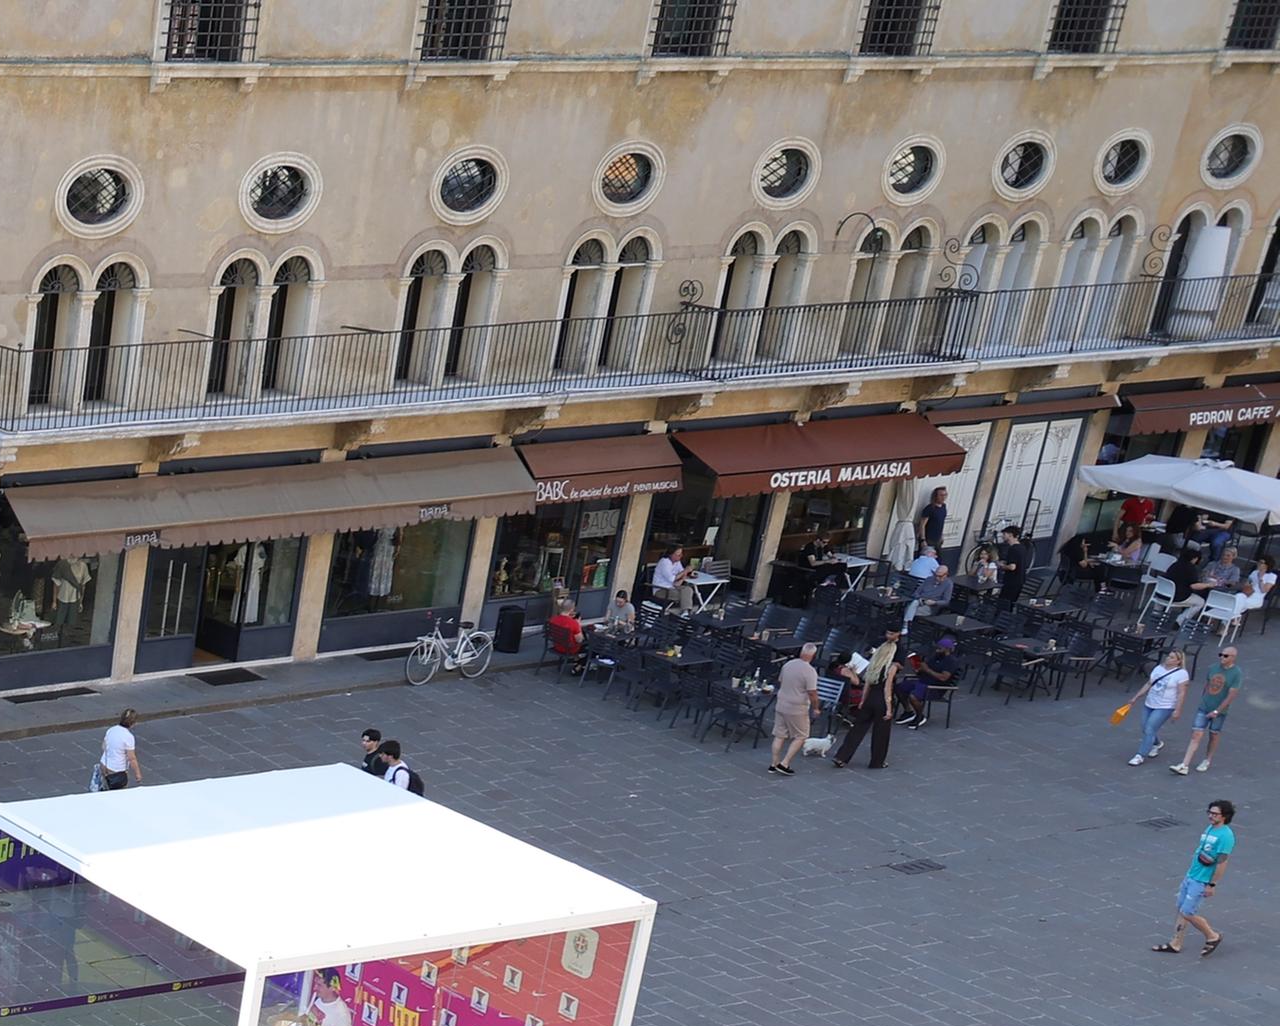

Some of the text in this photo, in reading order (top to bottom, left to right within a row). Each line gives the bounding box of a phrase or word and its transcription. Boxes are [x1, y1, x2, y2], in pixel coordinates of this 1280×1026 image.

[1189, 409, 1233, 426] PEDRON
[770, 461, 911, 488] OSTERIA MALVASIA
[536, 479, 570, 502] BABC
